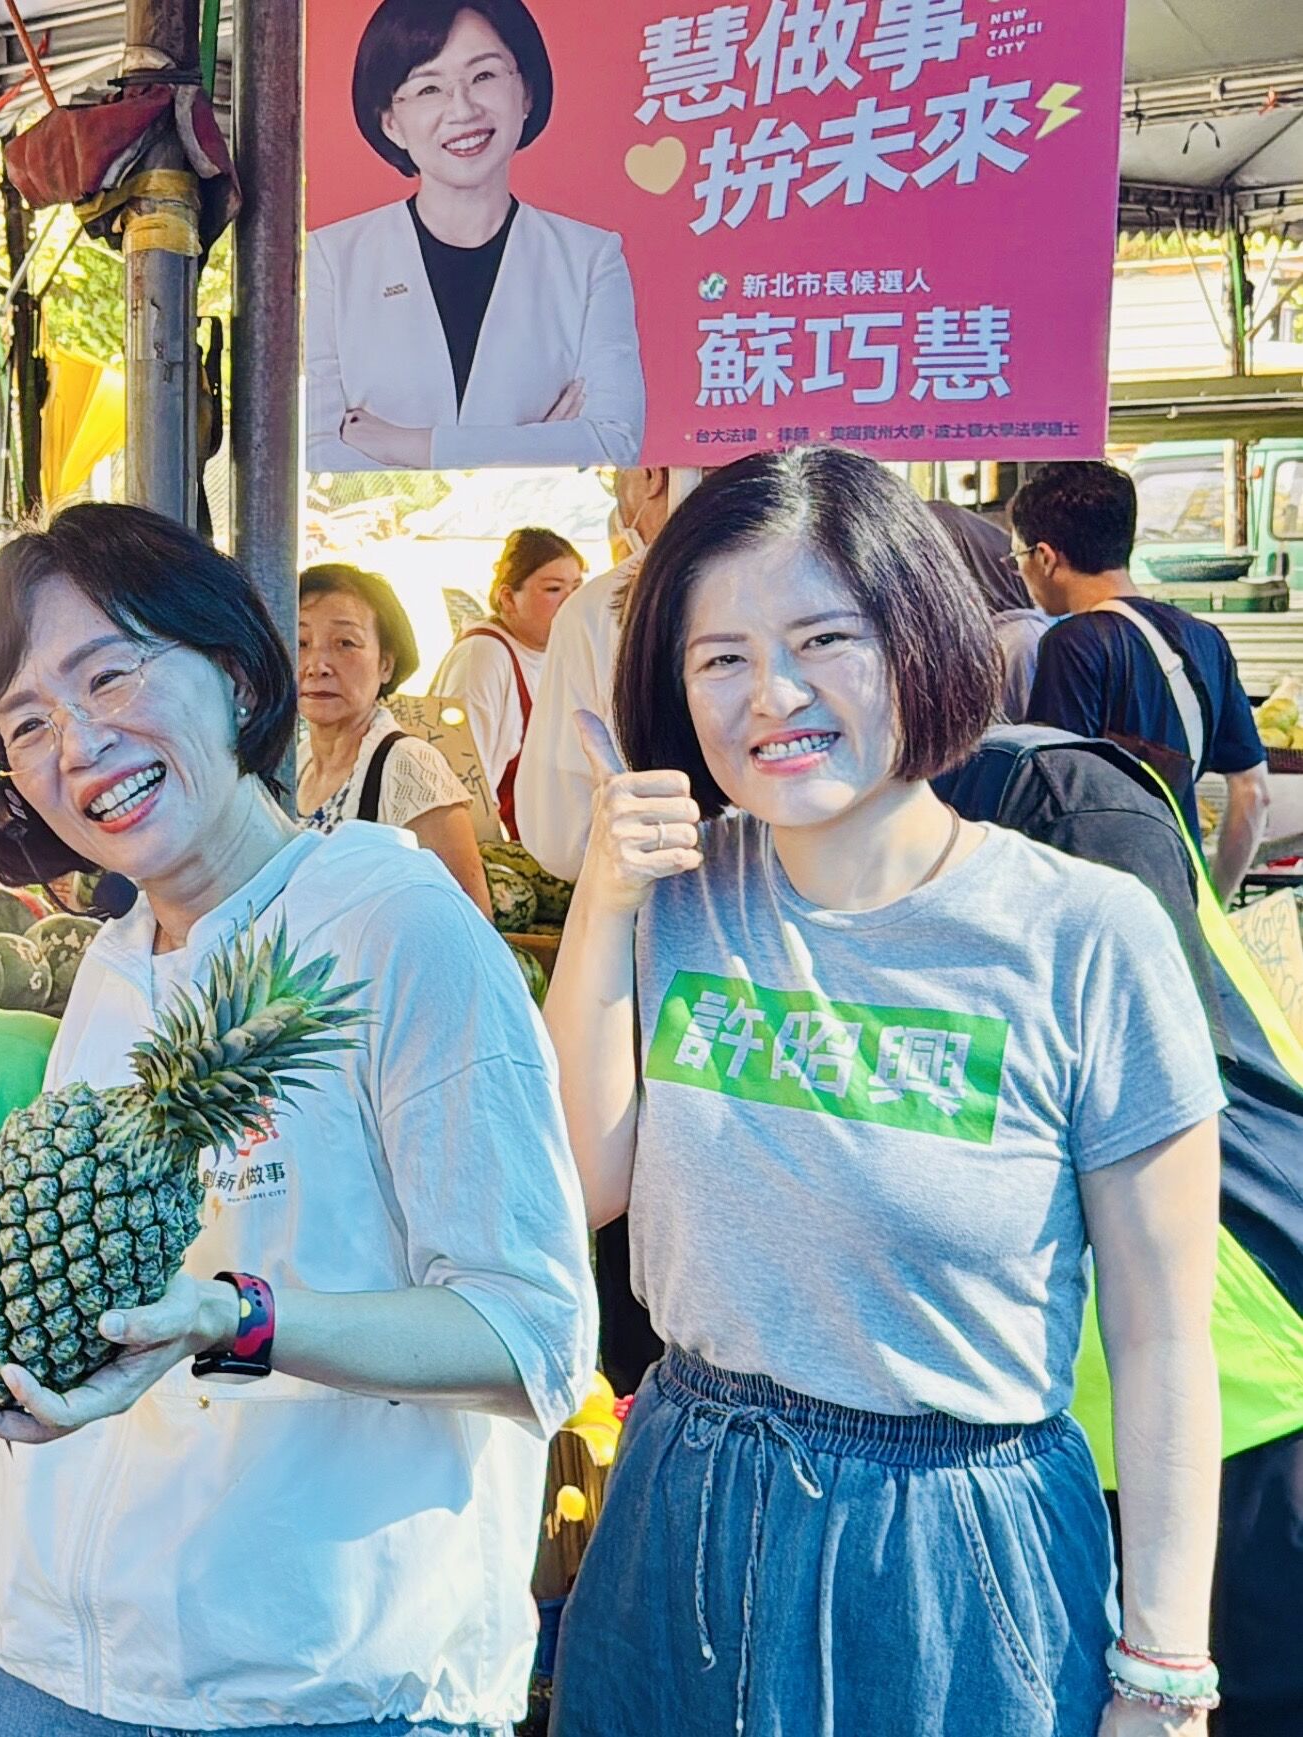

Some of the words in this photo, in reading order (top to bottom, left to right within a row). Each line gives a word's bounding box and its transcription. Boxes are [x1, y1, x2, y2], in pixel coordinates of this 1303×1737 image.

[988, 21, 1042, 41] TAIPEI
[990, 8, 1027, 25] NEW
[633, 0, 977, 126] 慧做事
[986, 39, 1026, 58] CITY
[741, 267, 931, 298] 新北市長候選人
[695, 304, 1011, 407] 蘇巧慧
[673, 990, 973, 1117] 許昭興
